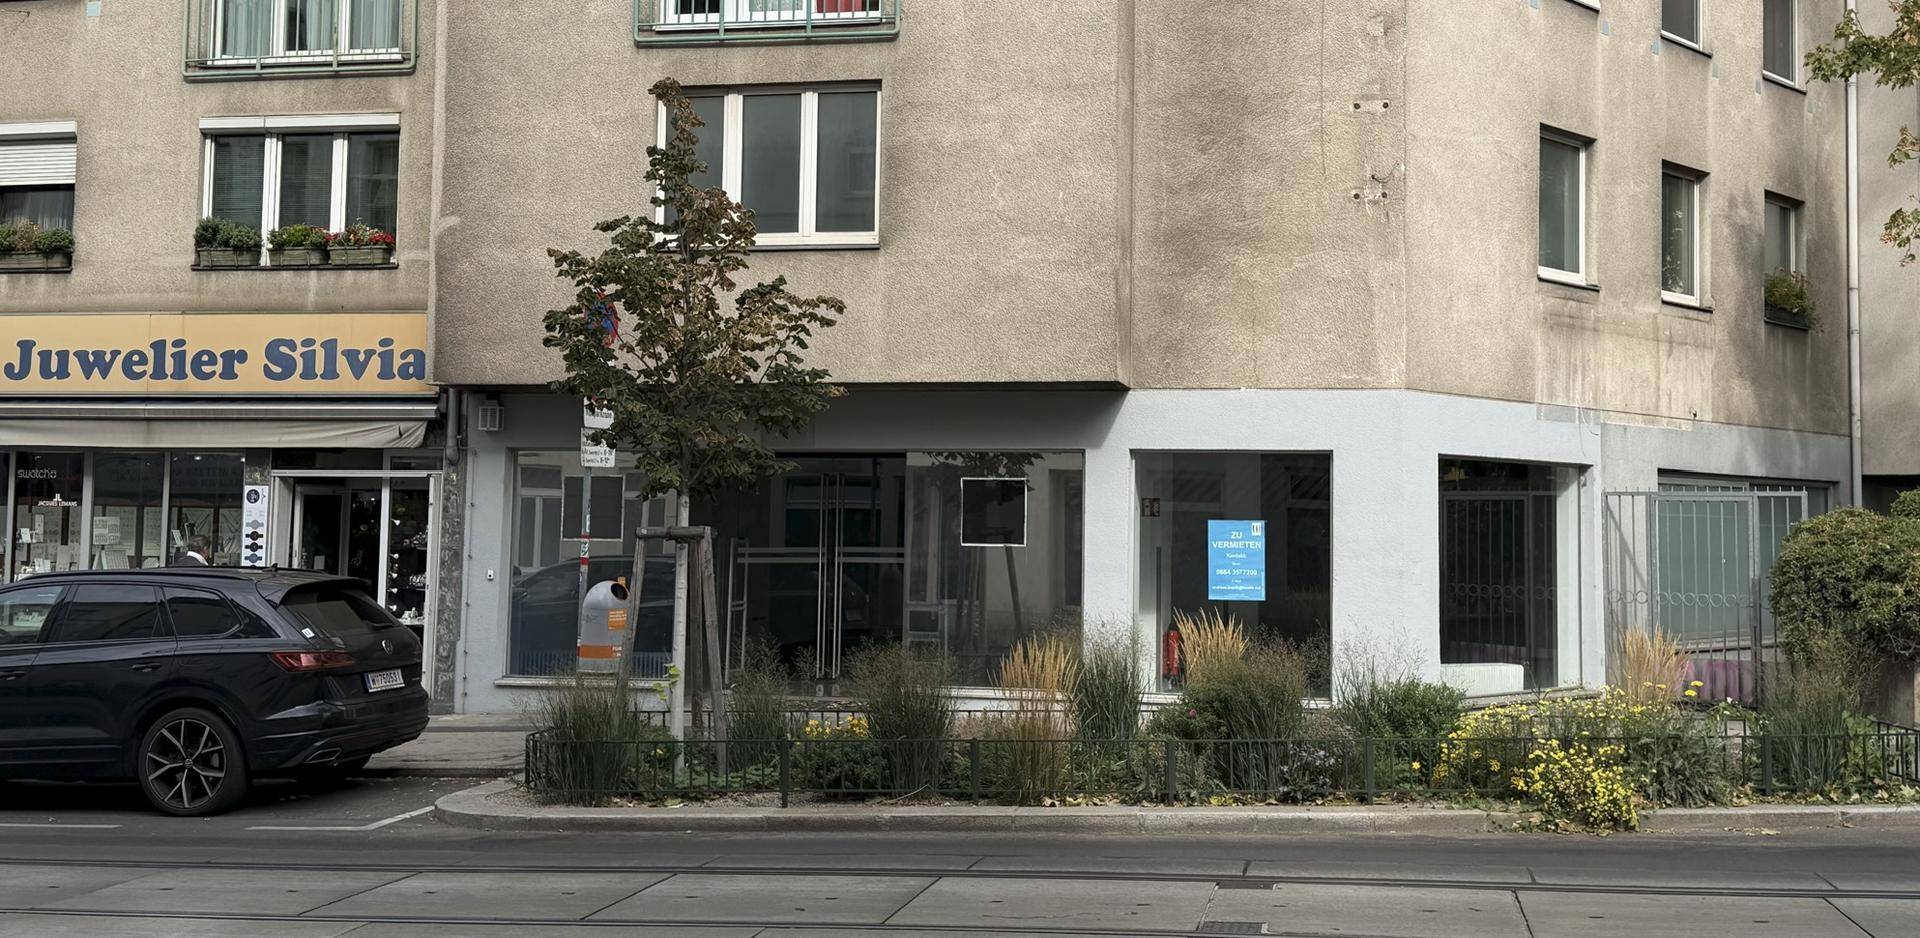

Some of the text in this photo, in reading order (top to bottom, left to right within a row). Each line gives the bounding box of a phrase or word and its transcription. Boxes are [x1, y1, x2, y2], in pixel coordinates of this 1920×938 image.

[4, 336, 427, 381] Juwelier Silvia
[17, 469, 50, 478] swatch
